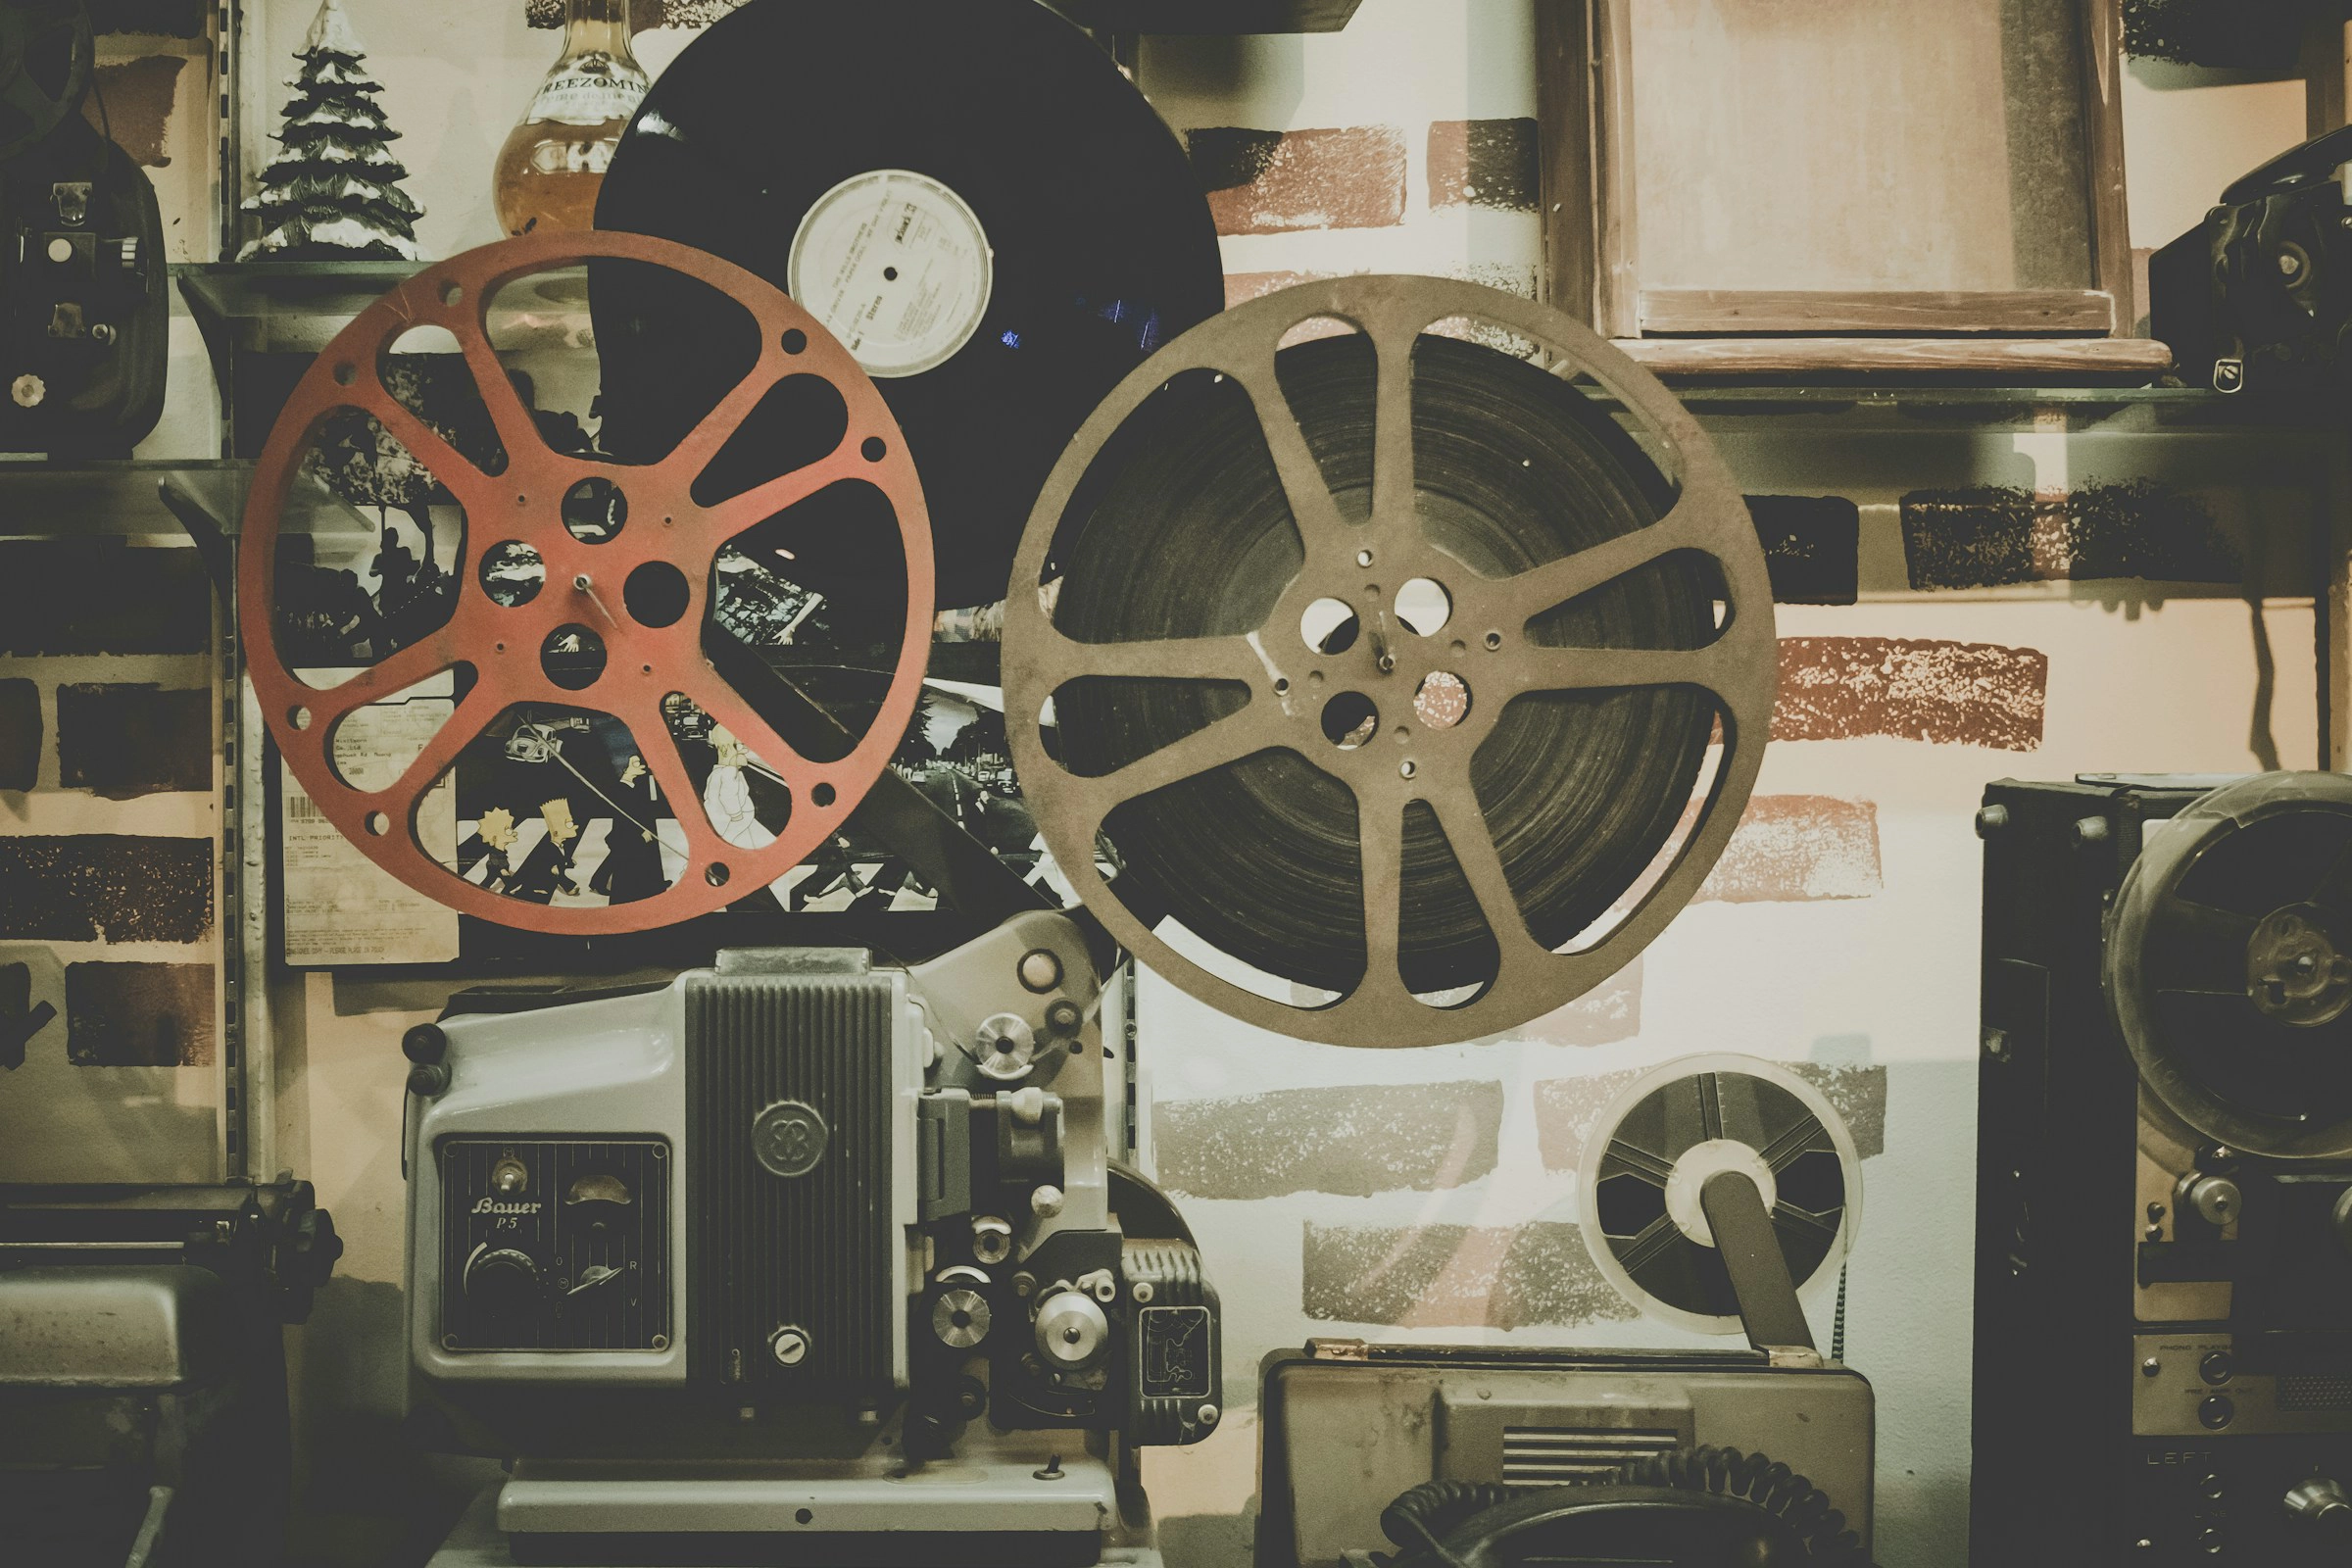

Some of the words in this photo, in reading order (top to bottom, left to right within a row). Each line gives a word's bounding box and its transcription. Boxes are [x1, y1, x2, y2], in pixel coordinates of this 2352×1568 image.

[541, 77, 649, 94] REEZOMIN
[865, 295, 883, 320] Stereo
[470, 1197, 542, 1214] Bauer
[629, 1260, 637, 1270] R
[2146, 1451, 2212, 1465] LEFT
